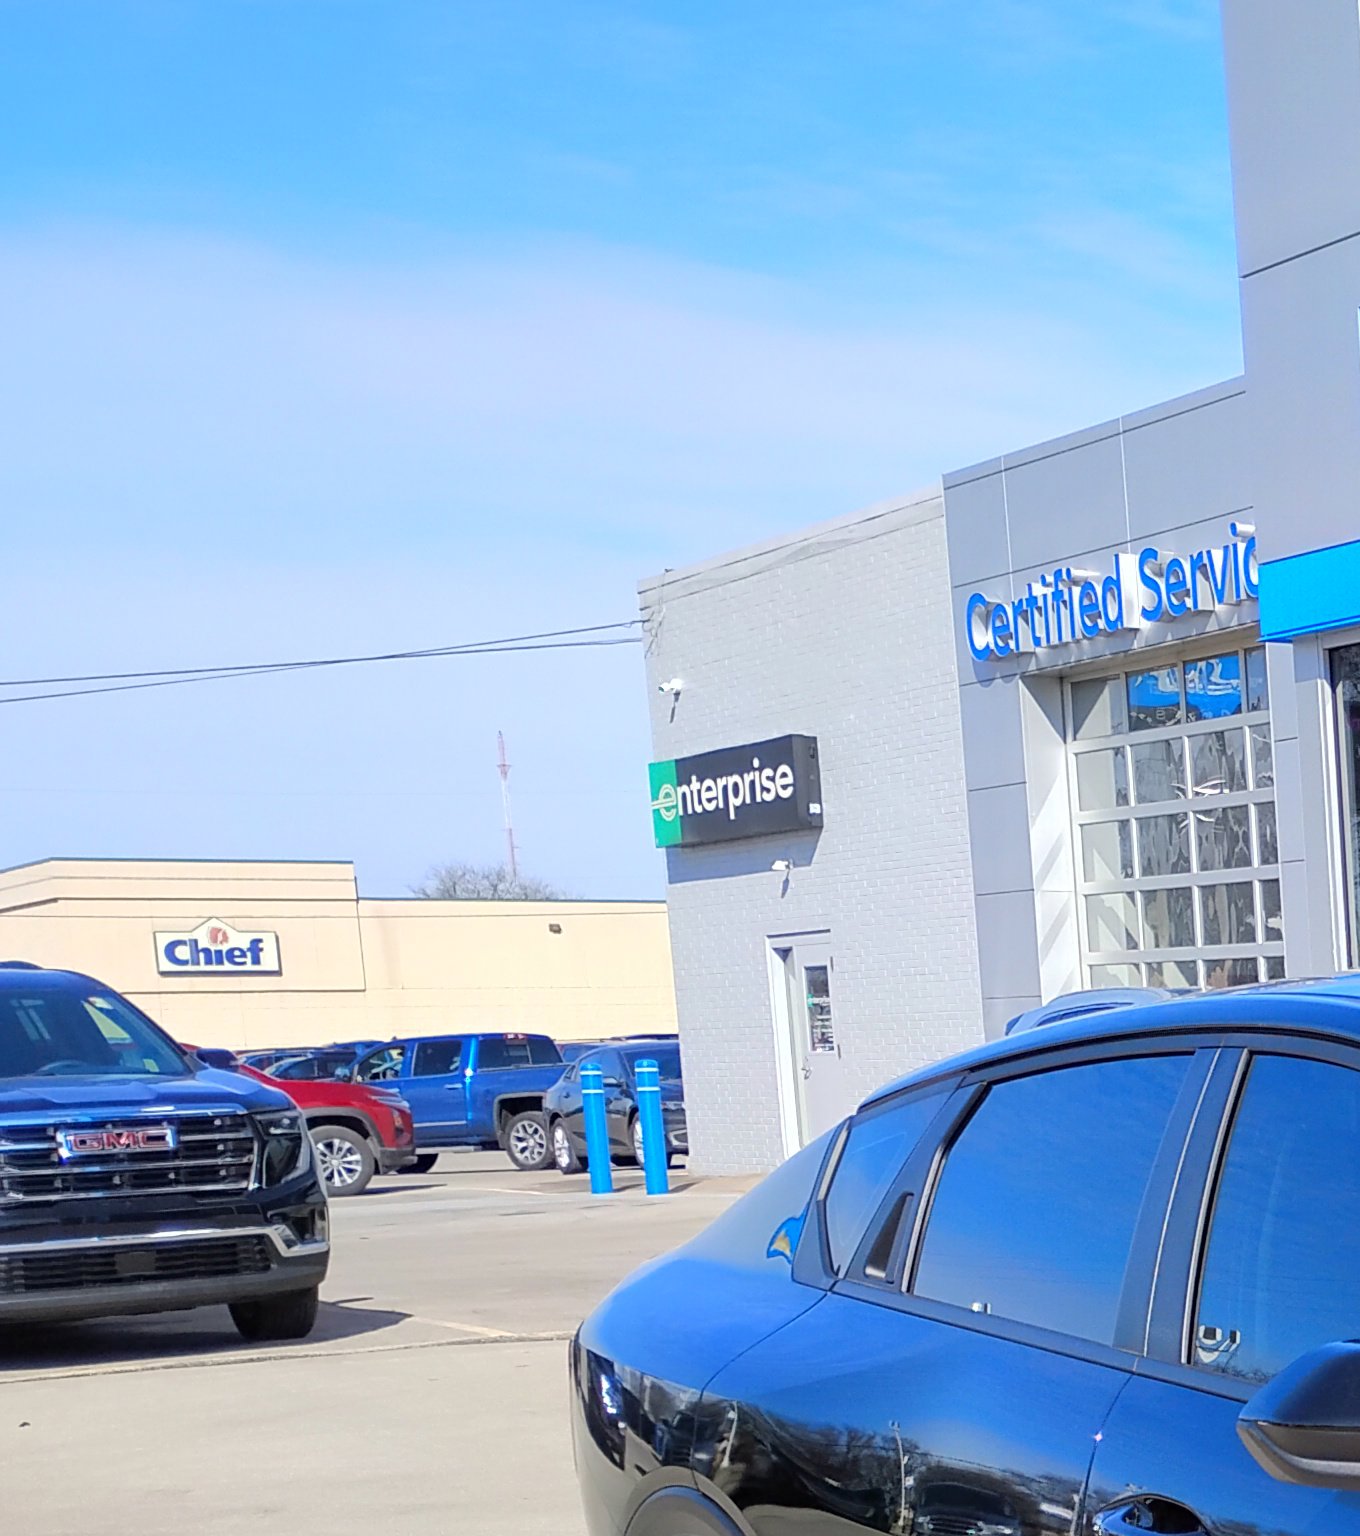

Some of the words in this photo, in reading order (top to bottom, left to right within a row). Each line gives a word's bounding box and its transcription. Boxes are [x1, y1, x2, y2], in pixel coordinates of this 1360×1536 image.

[965, 552, 1125, 662] Certified
[653, 756, 795, 822] enterprise
[163, 937, 264, 967] Chief
[71, 1129, 170, 1152] GMC
